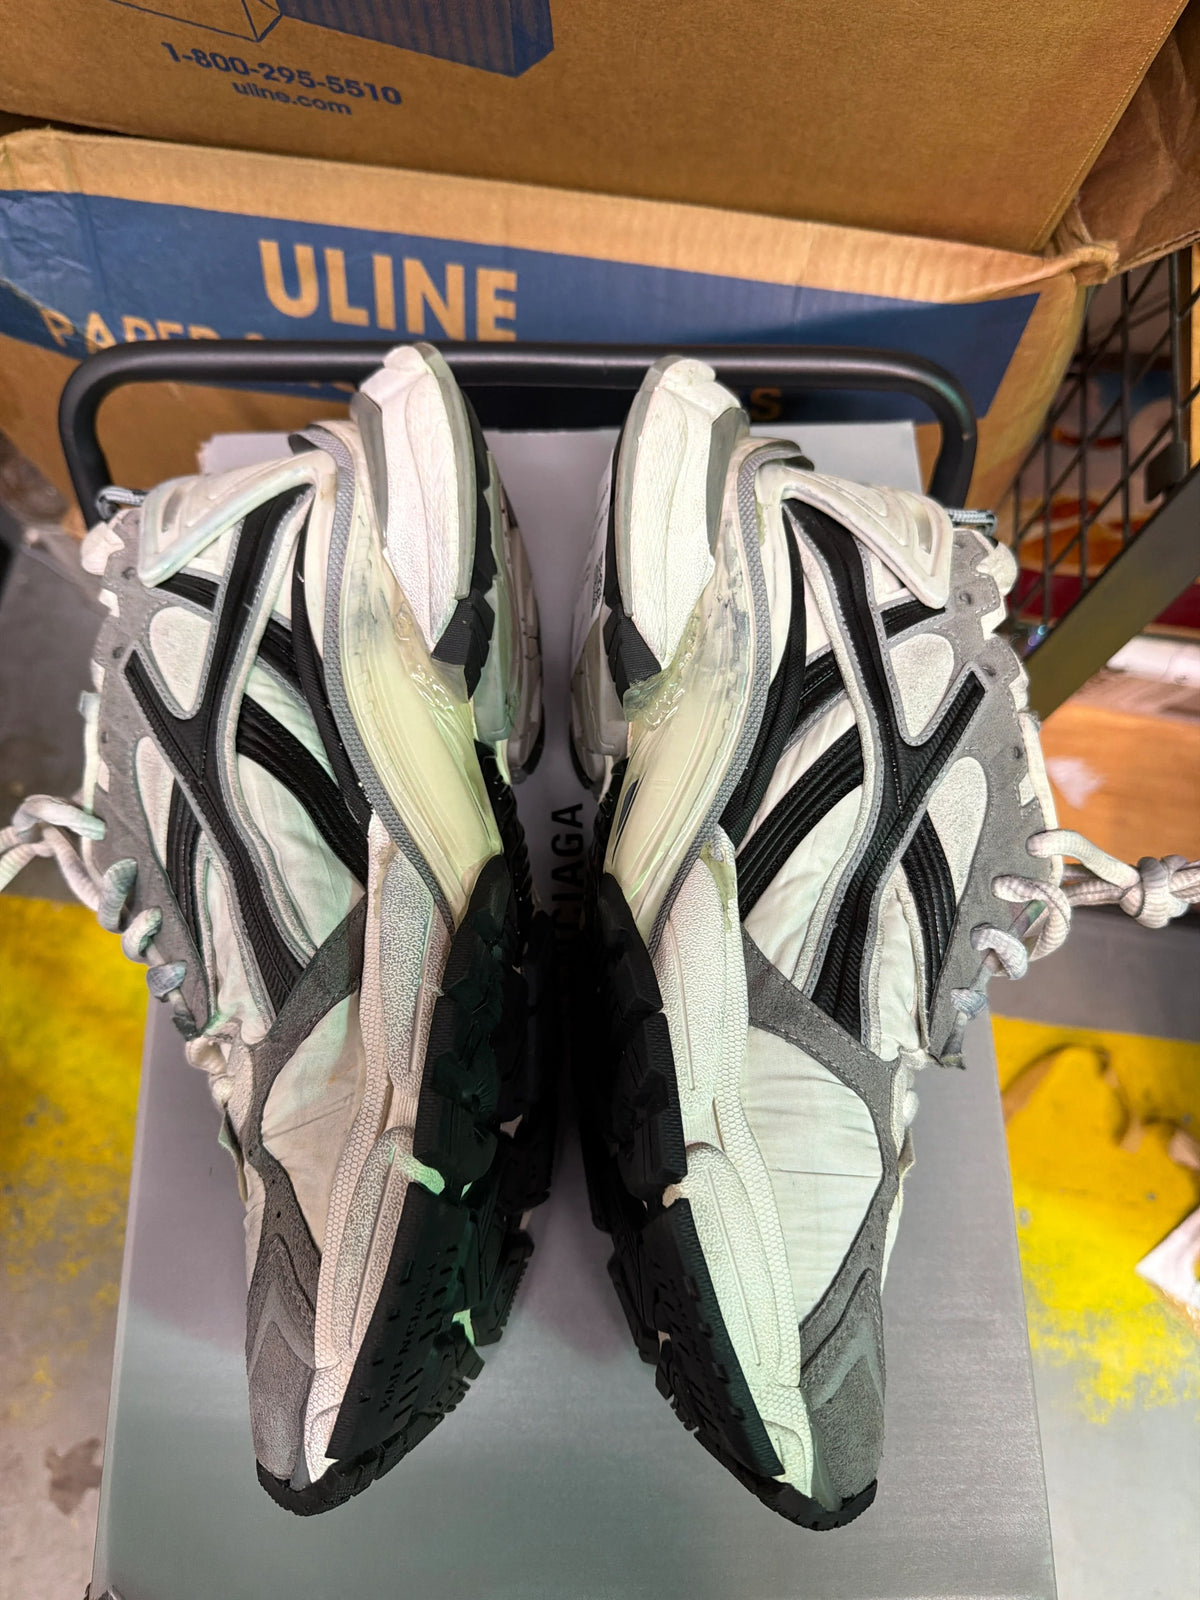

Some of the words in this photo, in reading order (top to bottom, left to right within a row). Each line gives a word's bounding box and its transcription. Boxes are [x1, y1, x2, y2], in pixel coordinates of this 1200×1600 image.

[161, 42, 402, 105] 1-800-295-5510
[232, 82, 352, 115] uline.com
[258, 239, 517, 342] ULINE
